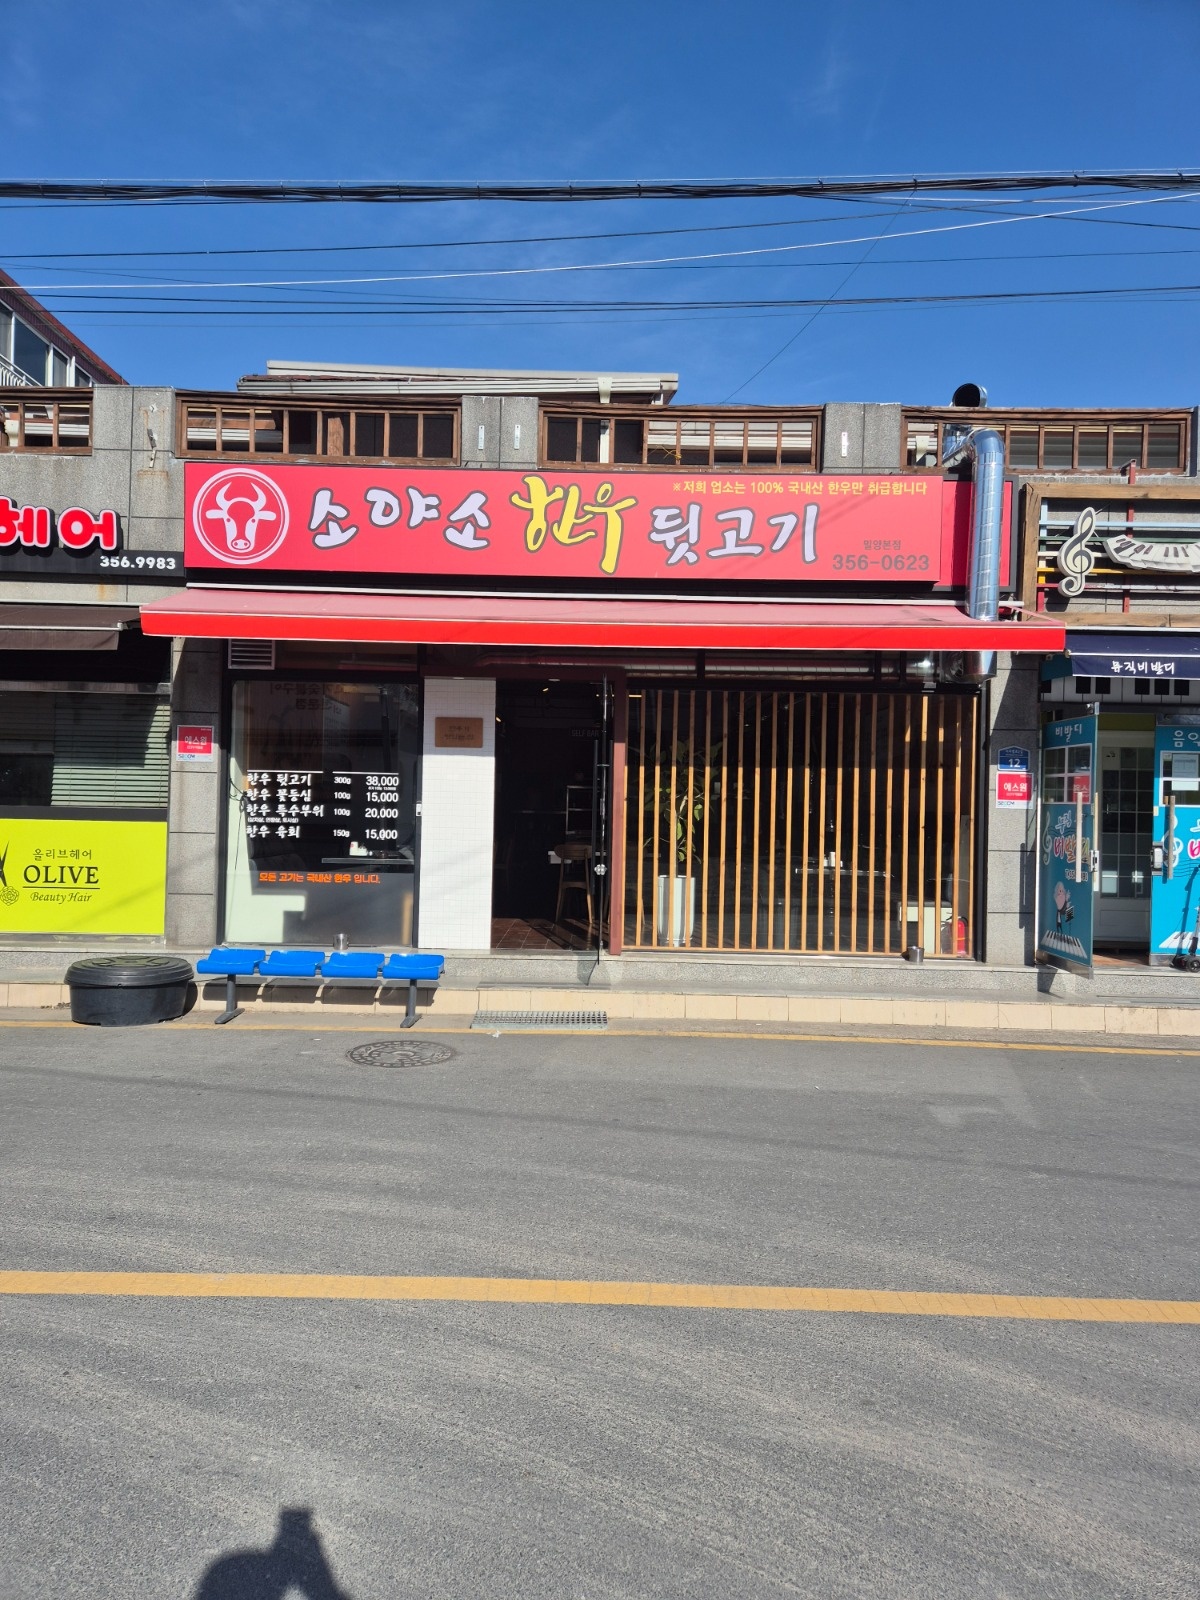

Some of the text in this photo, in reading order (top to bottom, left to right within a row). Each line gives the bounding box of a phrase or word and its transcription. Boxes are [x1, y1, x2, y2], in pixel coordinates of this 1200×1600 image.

[710, 481, 746, 494] 업소는
[750, 482, 784, 494] 100%
[787, 481, 824, 495] 국내산
[827, 481, 864, 495] 한우만
[867, 482, 928, 496] 취급합니다
[508, 473, 639, 576] 한우
[648, 502, 820, 567] 뒷고기
[862, 539, 902, 551] 밀양본점
[100, 555, 176, 570] 356.9983
[832, 554, 930, 571] 356-0623
[1055, 723, 1082, 743] 비발디
[1008, 758, 1021, 768] 12
[247, 773, 399, 787] 한우 뒷고기 300g 38,000
[1003, 782, 1028, 792] 에스원
[247, 788, 399, 803] 한우 꽃등심 100g 15,000
[246, 804, 398, 820] 한우 특수부위 100g 20,000
[246, 825, 398, 841] 한우 육회 150g 15,000
[32, 848, 93, 861] 올리브헤어
[23, 864, 100, 885] OLIVE
[30, 891, 93, 904] Beauty Hair
